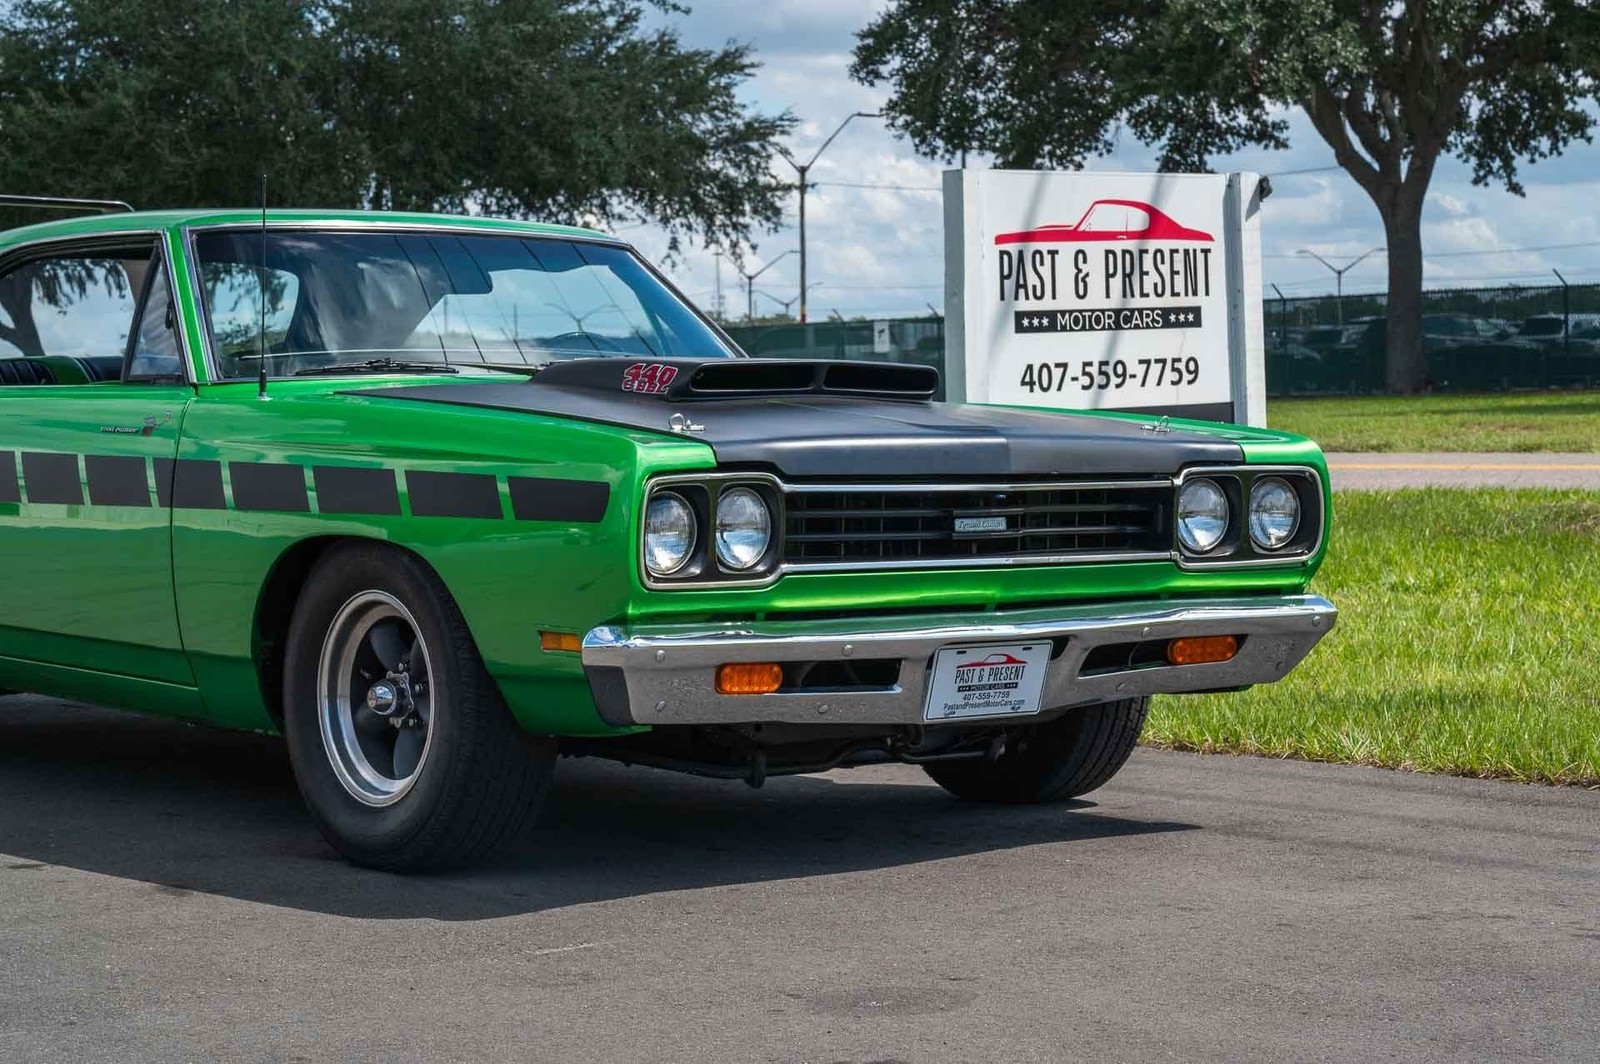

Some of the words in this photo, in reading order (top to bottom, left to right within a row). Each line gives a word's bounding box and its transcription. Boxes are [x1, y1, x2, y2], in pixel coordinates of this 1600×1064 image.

[999, 249, 1059, 301] PAST
[1073, 248, 1090, 300] &
[1104, 247, 1212, 299] PRESENT
[1057, 311, 1115, 331] MOTOR
[1120, 309, 1163, 328] CARS
[1020, 356, 1199, 393] 407-559-7759
[954, 669, 976, 684] PAST
[978, 668, 986, 683] &
[987, 665, 1026, 681] PRESENT
[963, 691, 1010, 700] 407-559-7759
